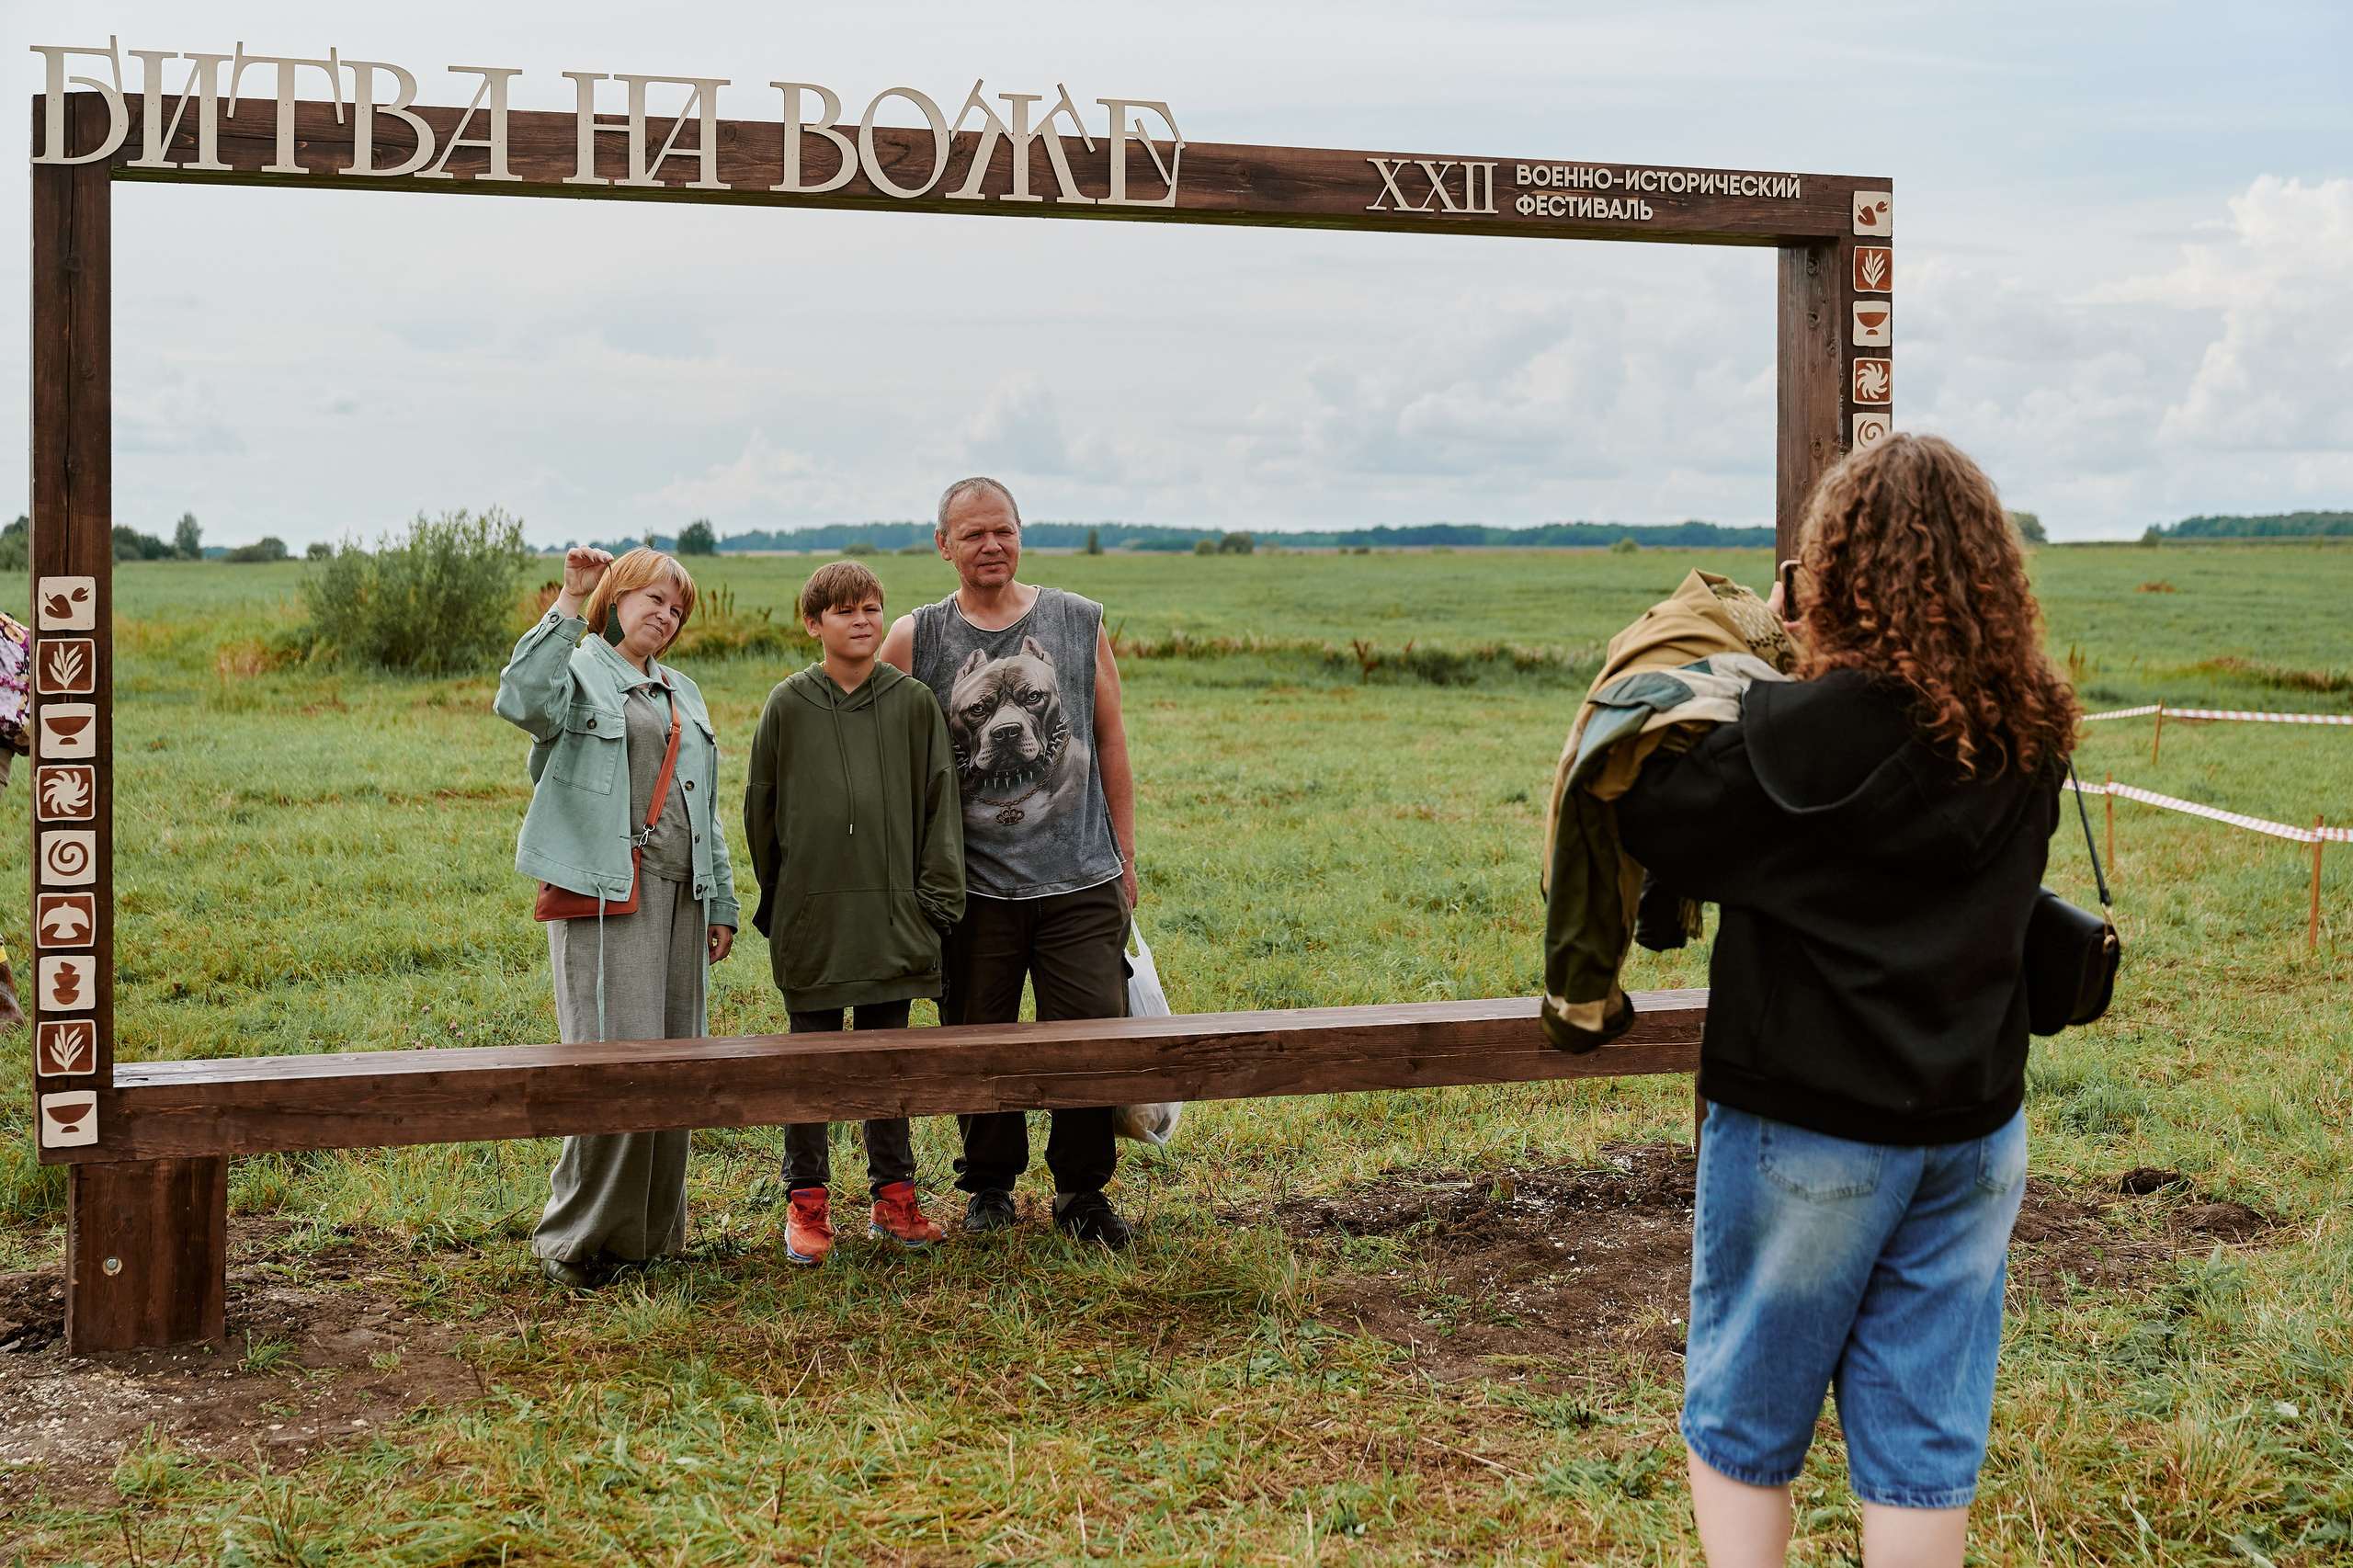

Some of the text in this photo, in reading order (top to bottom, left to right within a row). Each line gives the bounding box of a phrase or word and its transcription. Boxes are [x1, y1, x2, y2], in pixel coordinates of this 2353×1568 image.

[30, 35, 1186, 208] БИТВА НА ВОЖЕ
[1366, 157, 1499, 214] XXII
[1516, 164, 1802, 199] ВОЕННО-ИСТОРИЧЕСКИЙ
[1515, 194, 1654, 221] ФЕСТИВАЛЬ
